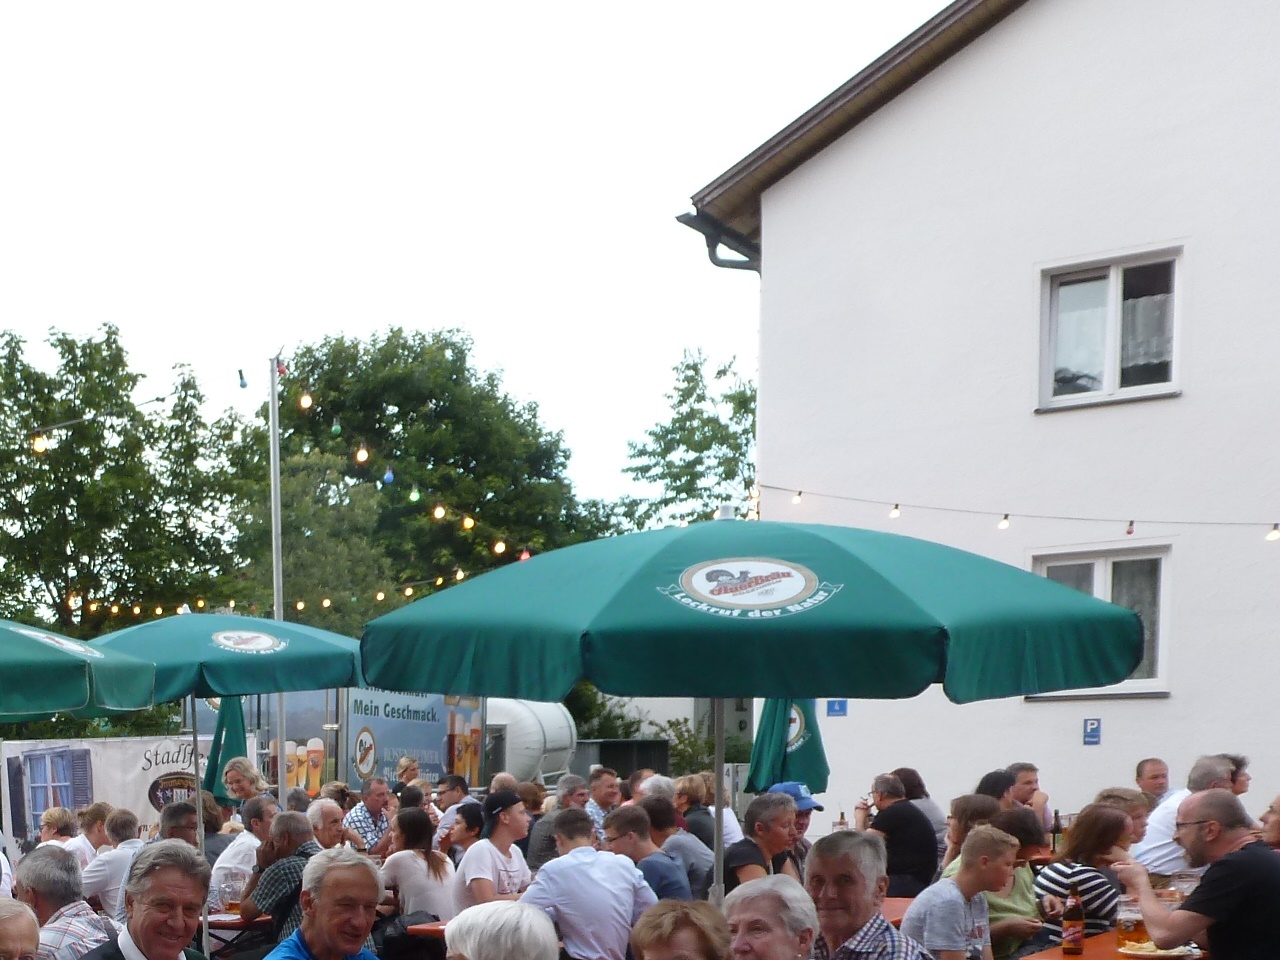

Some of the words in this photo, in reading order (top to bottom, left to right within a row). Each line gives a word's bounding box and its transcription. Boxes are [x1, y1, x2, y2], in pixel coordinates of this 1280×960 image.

[674, 592, 742, 618] Lockruf
[747, 608, 782, 618] der
[786, 590, 830, 613] Natur
[353, 699, 380, 716] Mein
[383, 702, 440, 723] Geschmack.
[1087, 720, 1098, 733] P
